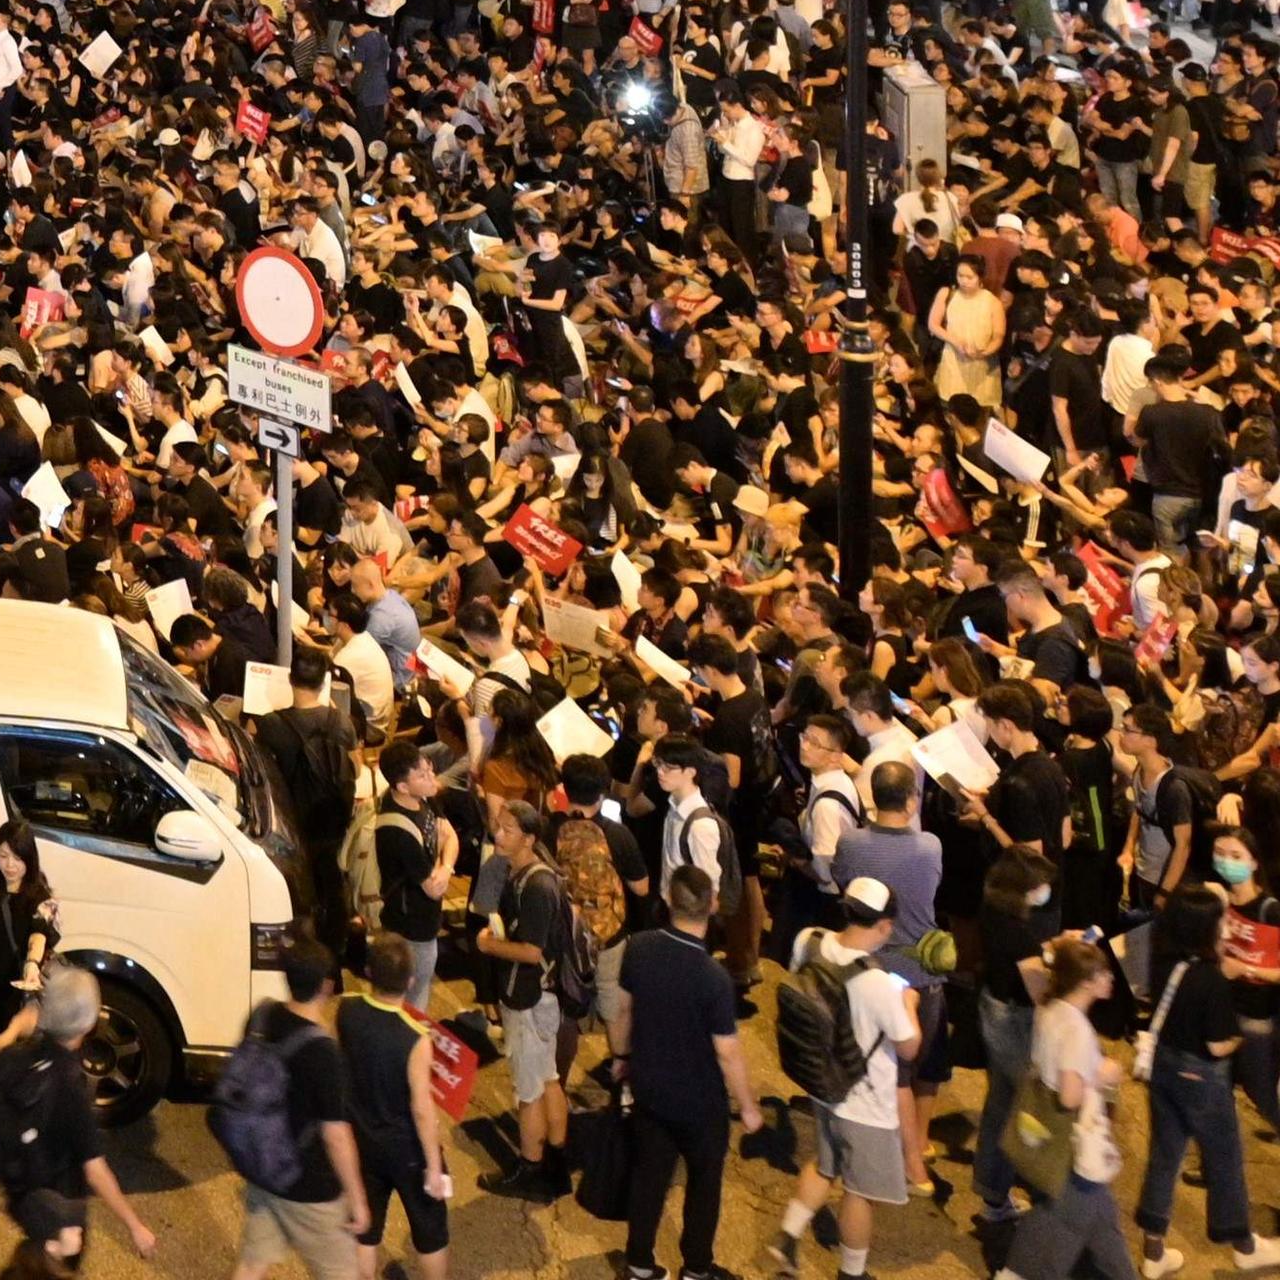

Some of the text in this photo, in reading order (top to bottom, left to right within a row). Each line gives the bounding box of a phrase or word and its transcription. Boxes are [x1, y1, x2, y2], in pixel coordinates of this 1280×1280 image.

[234, 351, 324, 389] Except franchised
[264, 376, 293, 395] buses
[237, 383, 322, 425] 專利巴士例外
[529, 517, 567, 548] FREE
